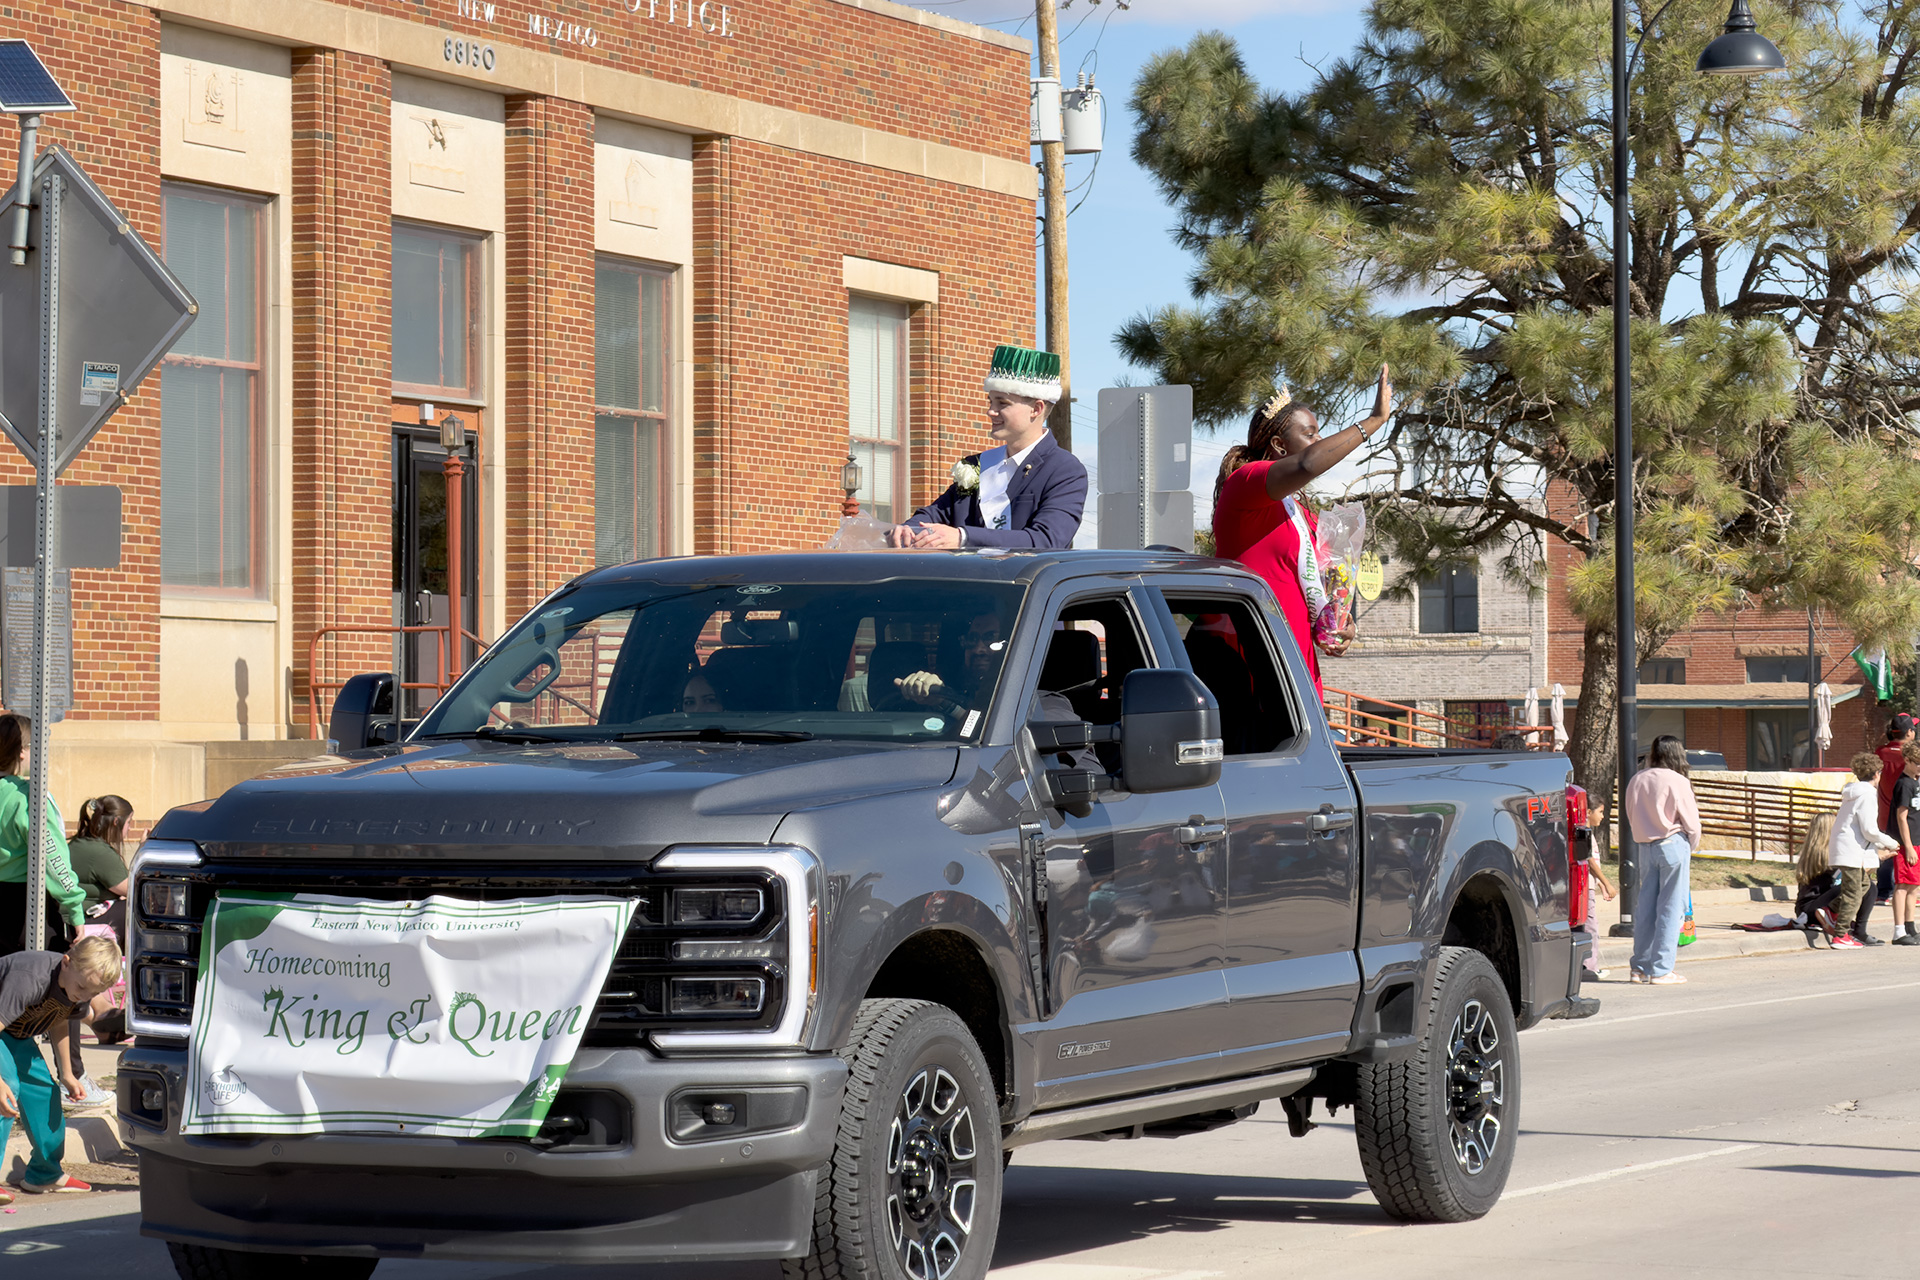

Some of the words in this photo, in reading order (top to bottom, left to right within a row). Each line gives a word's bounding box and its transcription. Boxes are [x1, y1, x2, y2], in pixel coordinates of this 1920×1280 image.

[458, 0, 495, 23] NEW
[528, 12, 597, 48] MEXICO
[444, 37, 495, 71] 88130
[1360, 559, 1379, 574] HIGH
[1361, 582, 1379, 593] SUPPLY
[1527, 795, 1562, 822] FX4
[251, 818, 430, 836] SUPER
[440, 818, 596, 836] DUTY
[50, 855, 75, 893] RIVER
[311, 917, 359, 930] Eastern
[363, 919, 391, 932] New
[394, 919, 439, 932] Mexico
[446, 919, 525, 931] University
[244, 948, 391, 987] Homecoming
[263, 993, 370, 1055] King
[387, 994, 431, 1045] &
[449, 999, 583, 1058] Queen
[204, 1080, 247, 1094] GREYHOUND
[213, 1090, 231, 1100] LIFE
